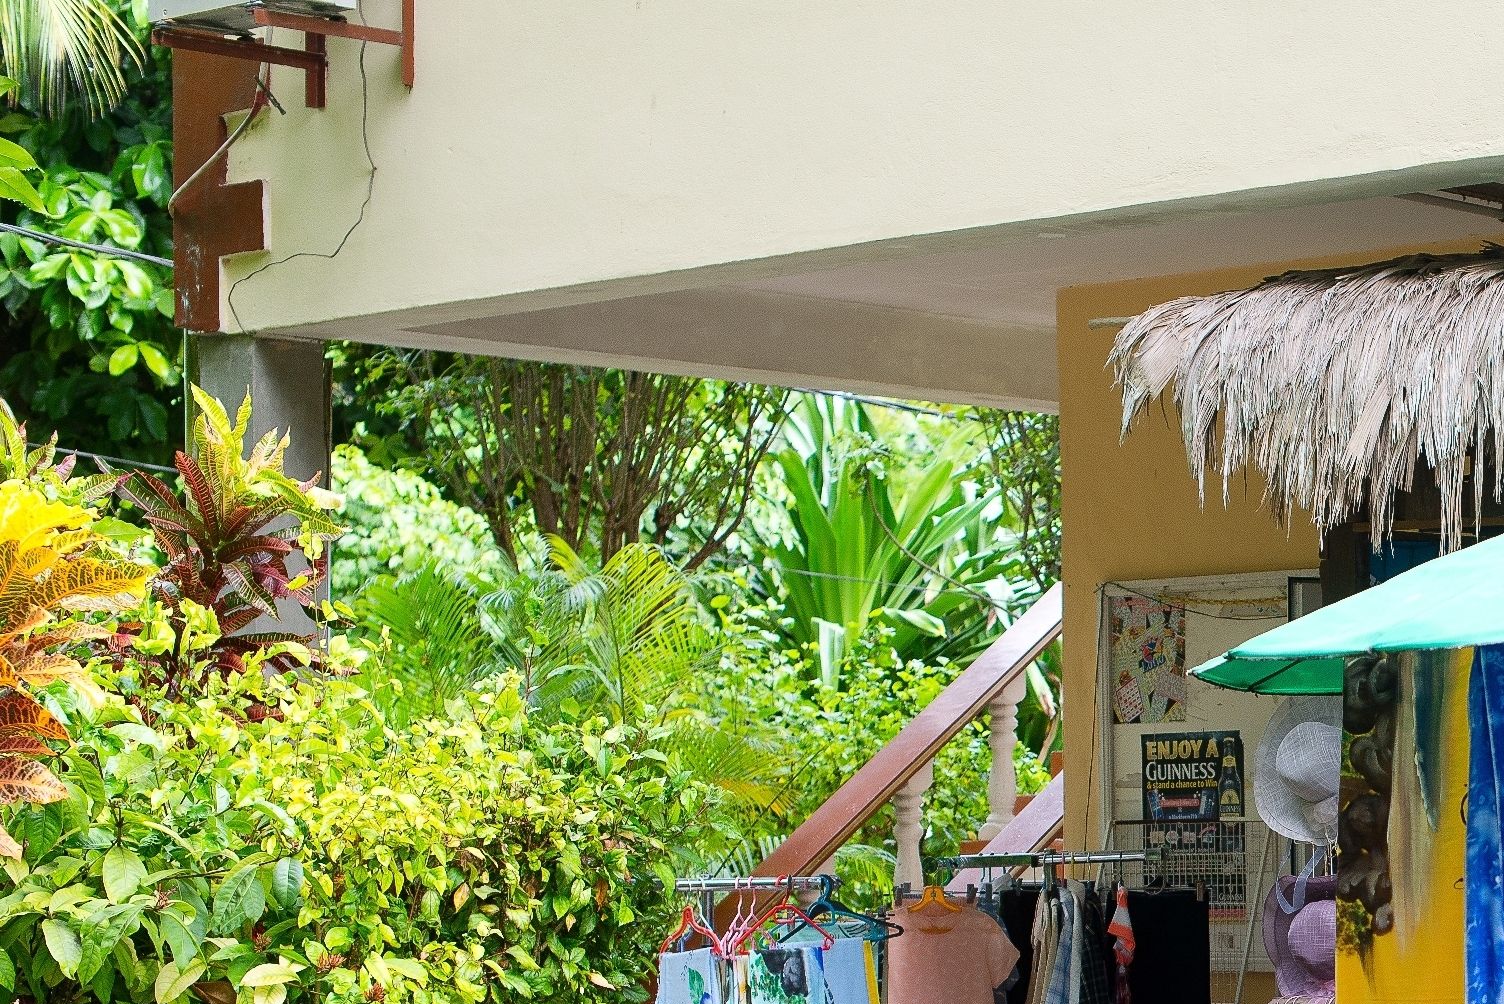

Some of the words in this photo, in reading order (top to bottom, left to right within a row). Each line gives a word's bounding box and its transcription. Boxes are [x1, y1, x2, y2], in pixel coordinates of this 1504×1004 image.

[1146, 739, 1202, 760] ENJOY
[1205, 738, 1219, 758] A
[1145, 761, 1216, 781] GUINNESS
[1146, 781, 1153, 789] &
[1153, 781, 1170, 789] stand
[1197, 780, 1204, 788] to
[1205, 779, 1218, 787] Win
